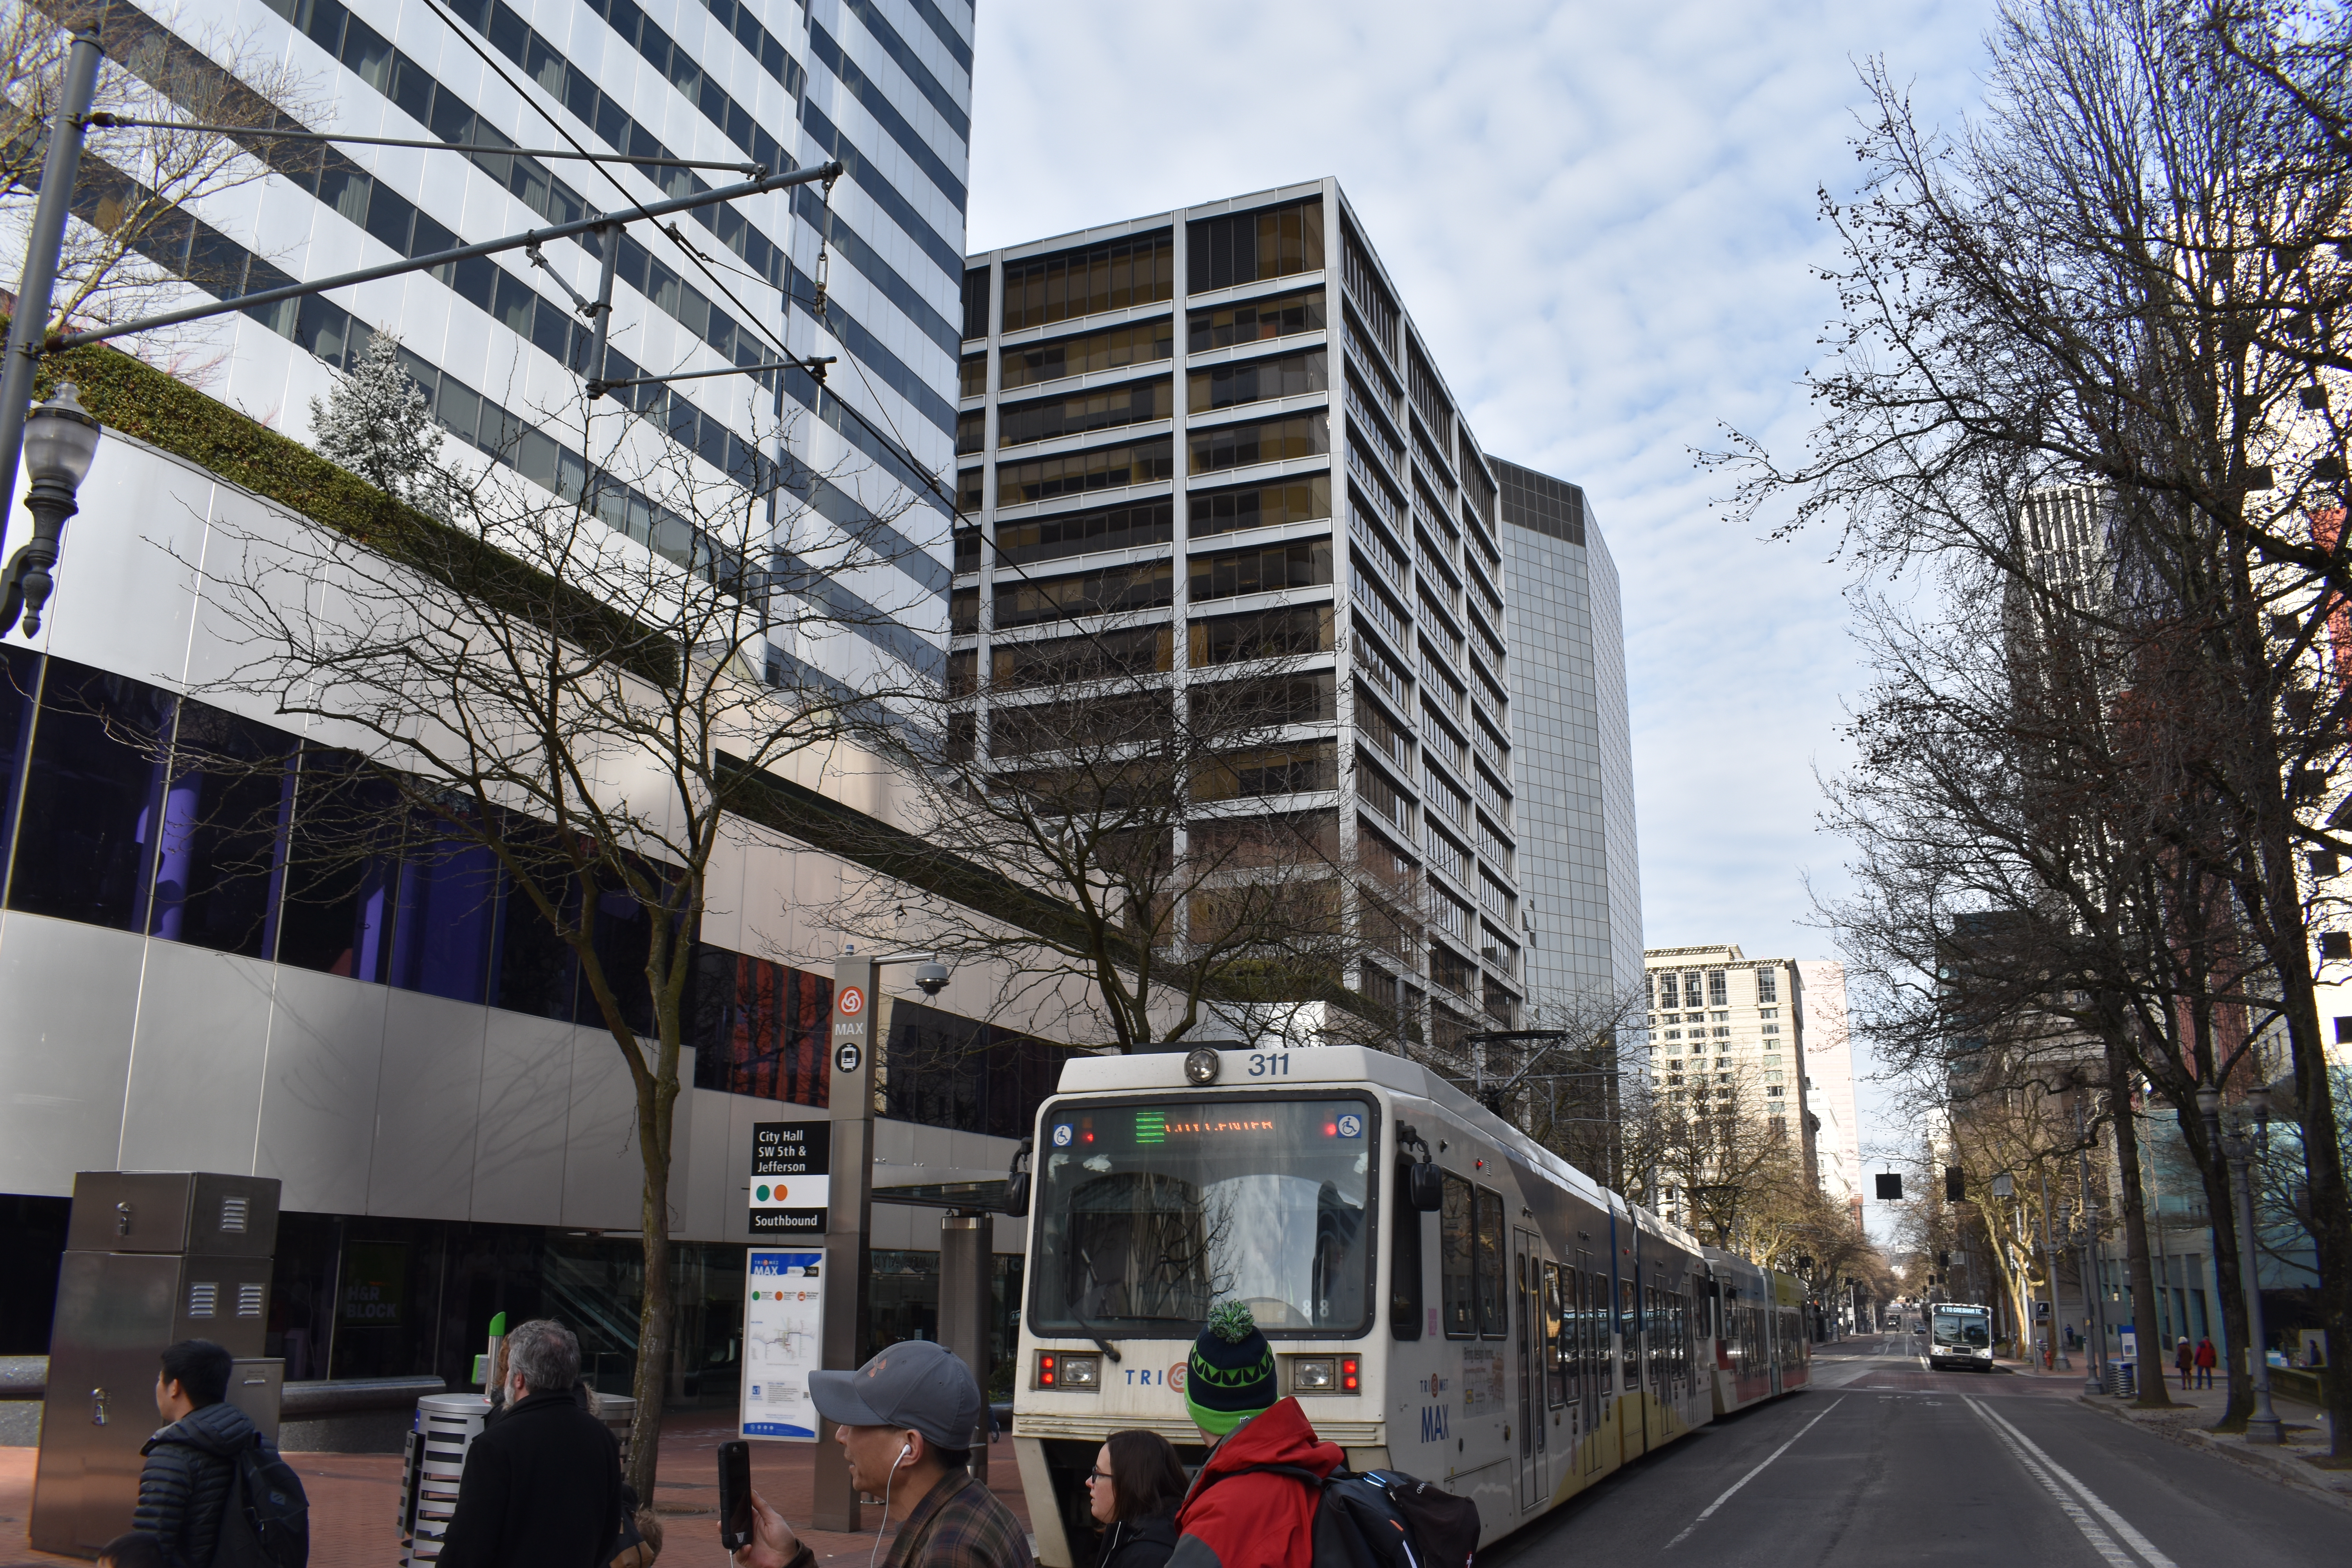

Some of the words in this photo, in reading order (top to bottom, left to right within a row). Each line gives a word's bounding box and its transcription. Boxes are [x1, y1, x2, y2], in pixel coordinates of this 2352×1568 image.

[835, 1022, 864, 1036] MAX
[1248, 1053, 1289, 1076] 311
[759, 1131, 780, 1144] City
[783, 1130, 803, 1141] Hall
[759, 1147, 775, 1157] SW
[777, 1146, 795, 1157] 5th
[798, 1146, 806, 1156] &
[757, 1161, 806, 1172] Jefferson
[755, 1215, 818, 1227] Southbound
[753, 1266, 779, 1276] MAX
[348, 1286, 380, 1301] H&R
[347, 1303, 397, 1318] BLOCK
[1125, 1369, 1162, 1385] TRI
[1420, 1380, 1430, 1393] TRI
[1421, 1404, 1449, 1443] MAX
